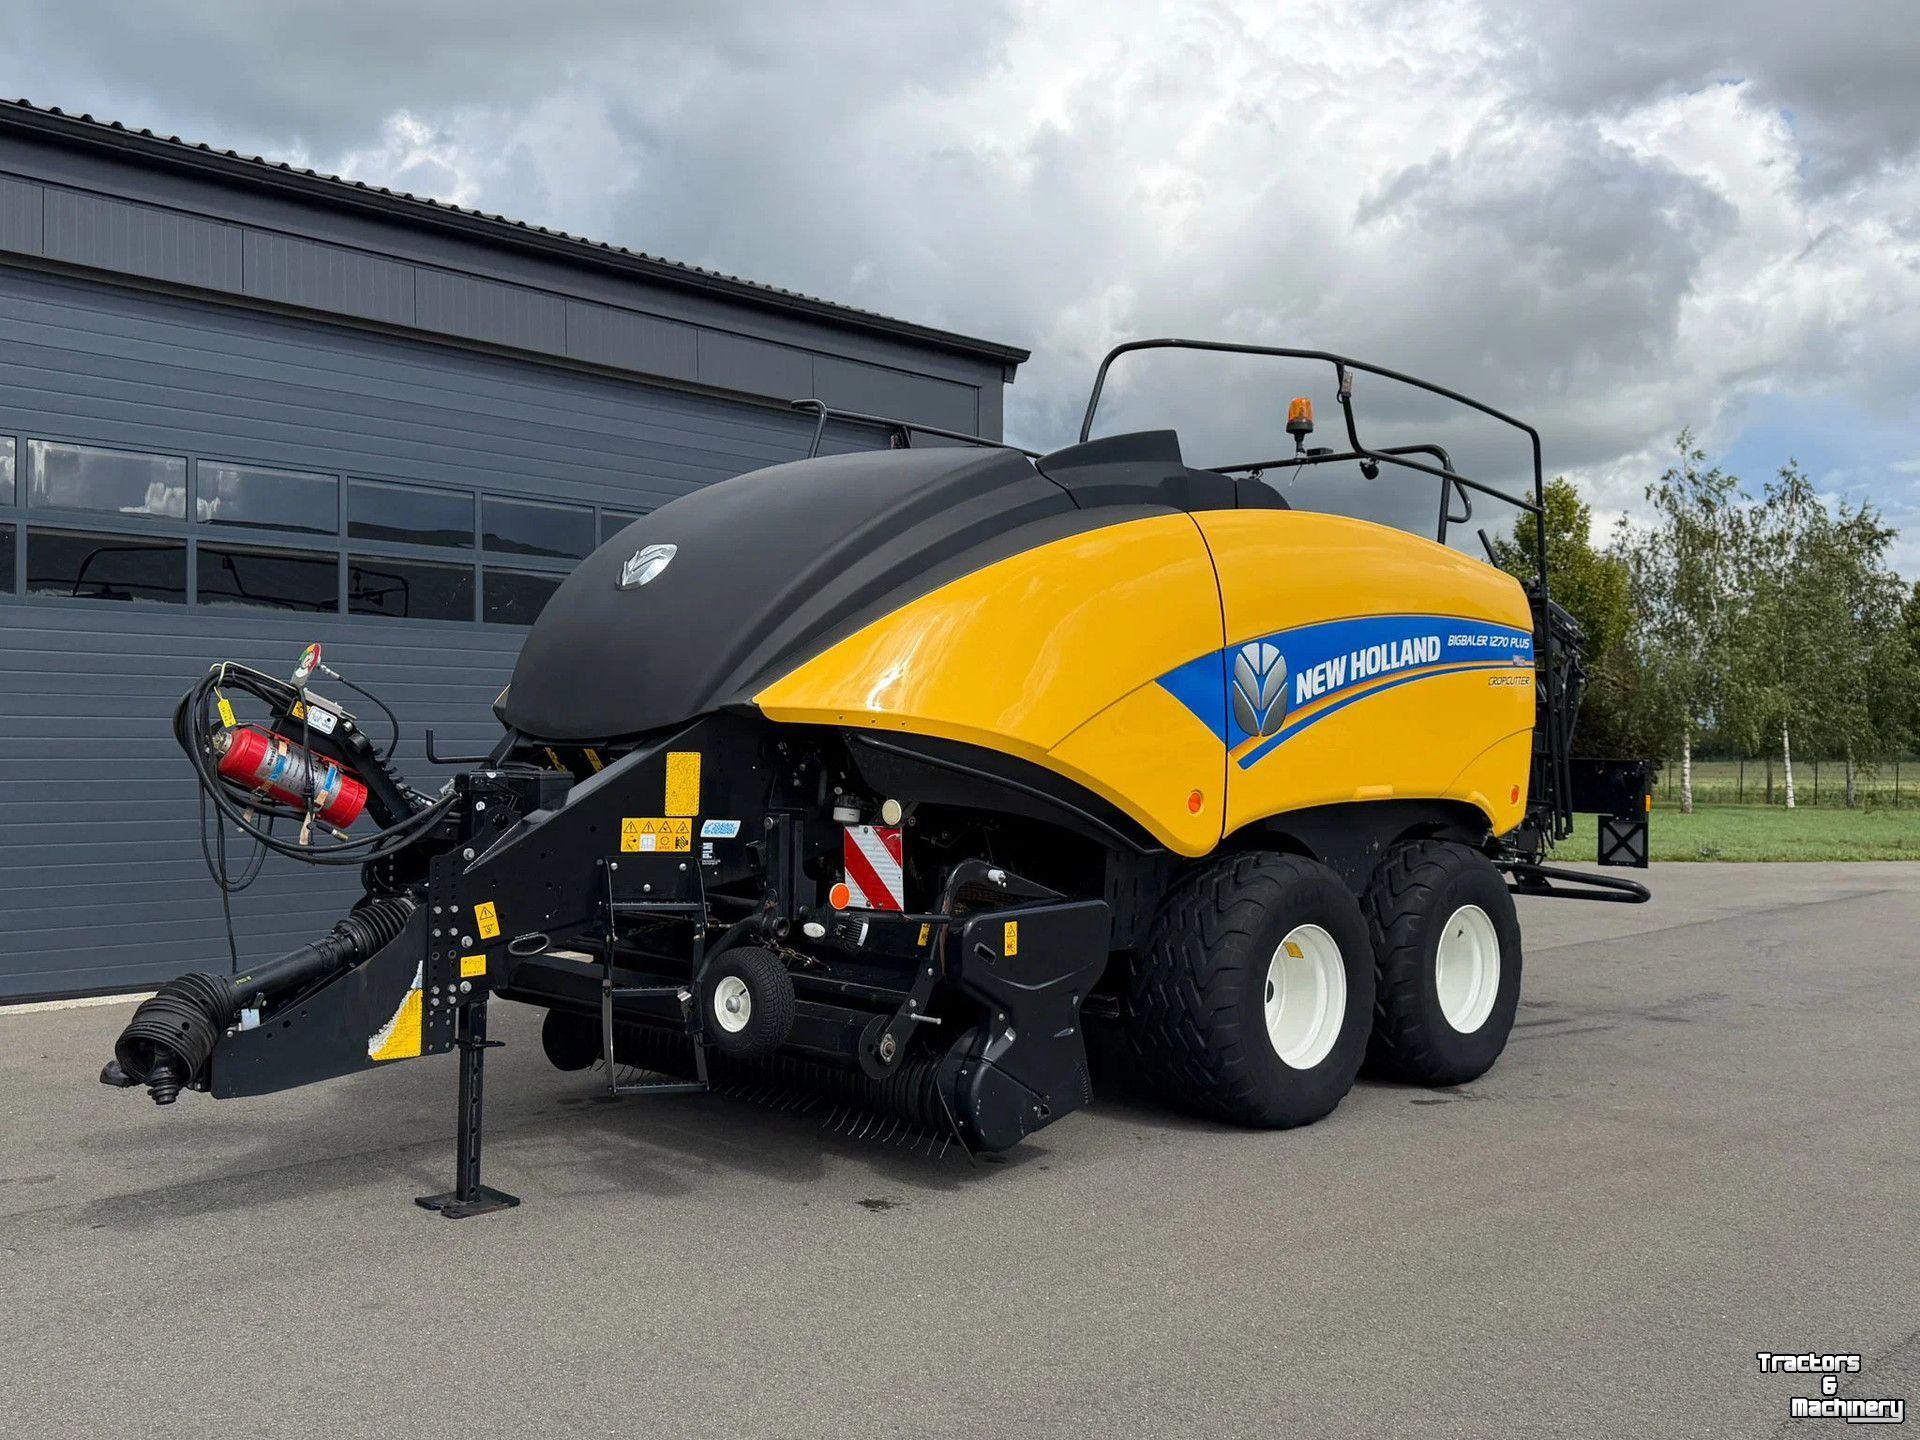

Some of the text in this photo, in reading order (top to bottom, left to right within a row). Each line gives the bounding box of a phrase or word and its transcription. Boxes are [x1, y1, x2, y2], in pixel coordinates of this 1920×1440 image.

[1447, 634, 1530, 649] BIGBALER 1270 PLUS
[1295, 635, 1441, 704] NEW HOLLAND
[1488, 676, 1531, 686] CROPCUTTER
